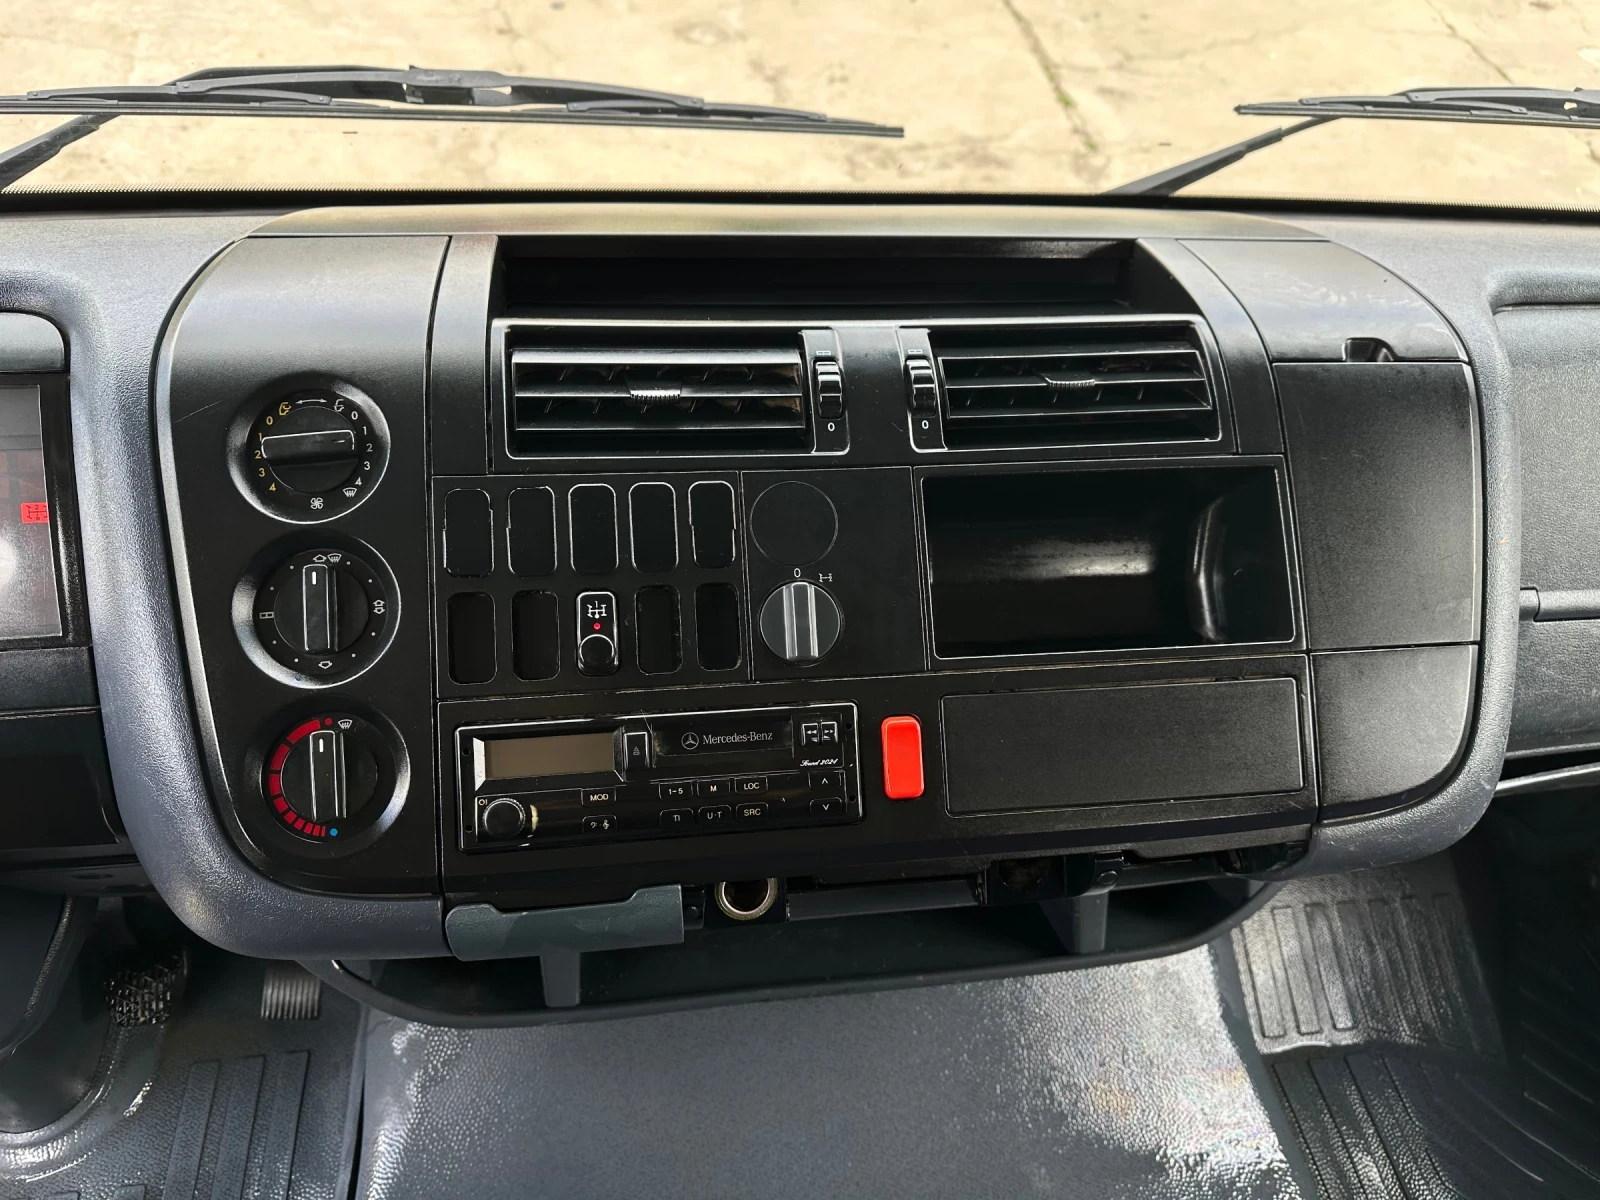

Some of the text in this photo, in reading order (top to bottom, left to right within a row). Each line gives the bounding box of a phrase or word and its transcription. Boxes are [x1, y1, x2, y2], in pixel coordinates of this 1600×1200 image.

[362, 426, 368, 436] 1
[366, 442, 374, 452] 2
[254, 450, 262, 460] 2
[363, 460, 372, 471] 3
[258, 468, 266, 477] 3
[355, 476, 363, 486] 4
[269, 482, 277, 492] 4
[702, 731, 773, 745] Mercedes-Benz
[710, 784, 718, 793] M
[743, 782, 760, 791] LOC
[589, 793, 609, 802] MOD
[743, 808, 761, 818] SRC
